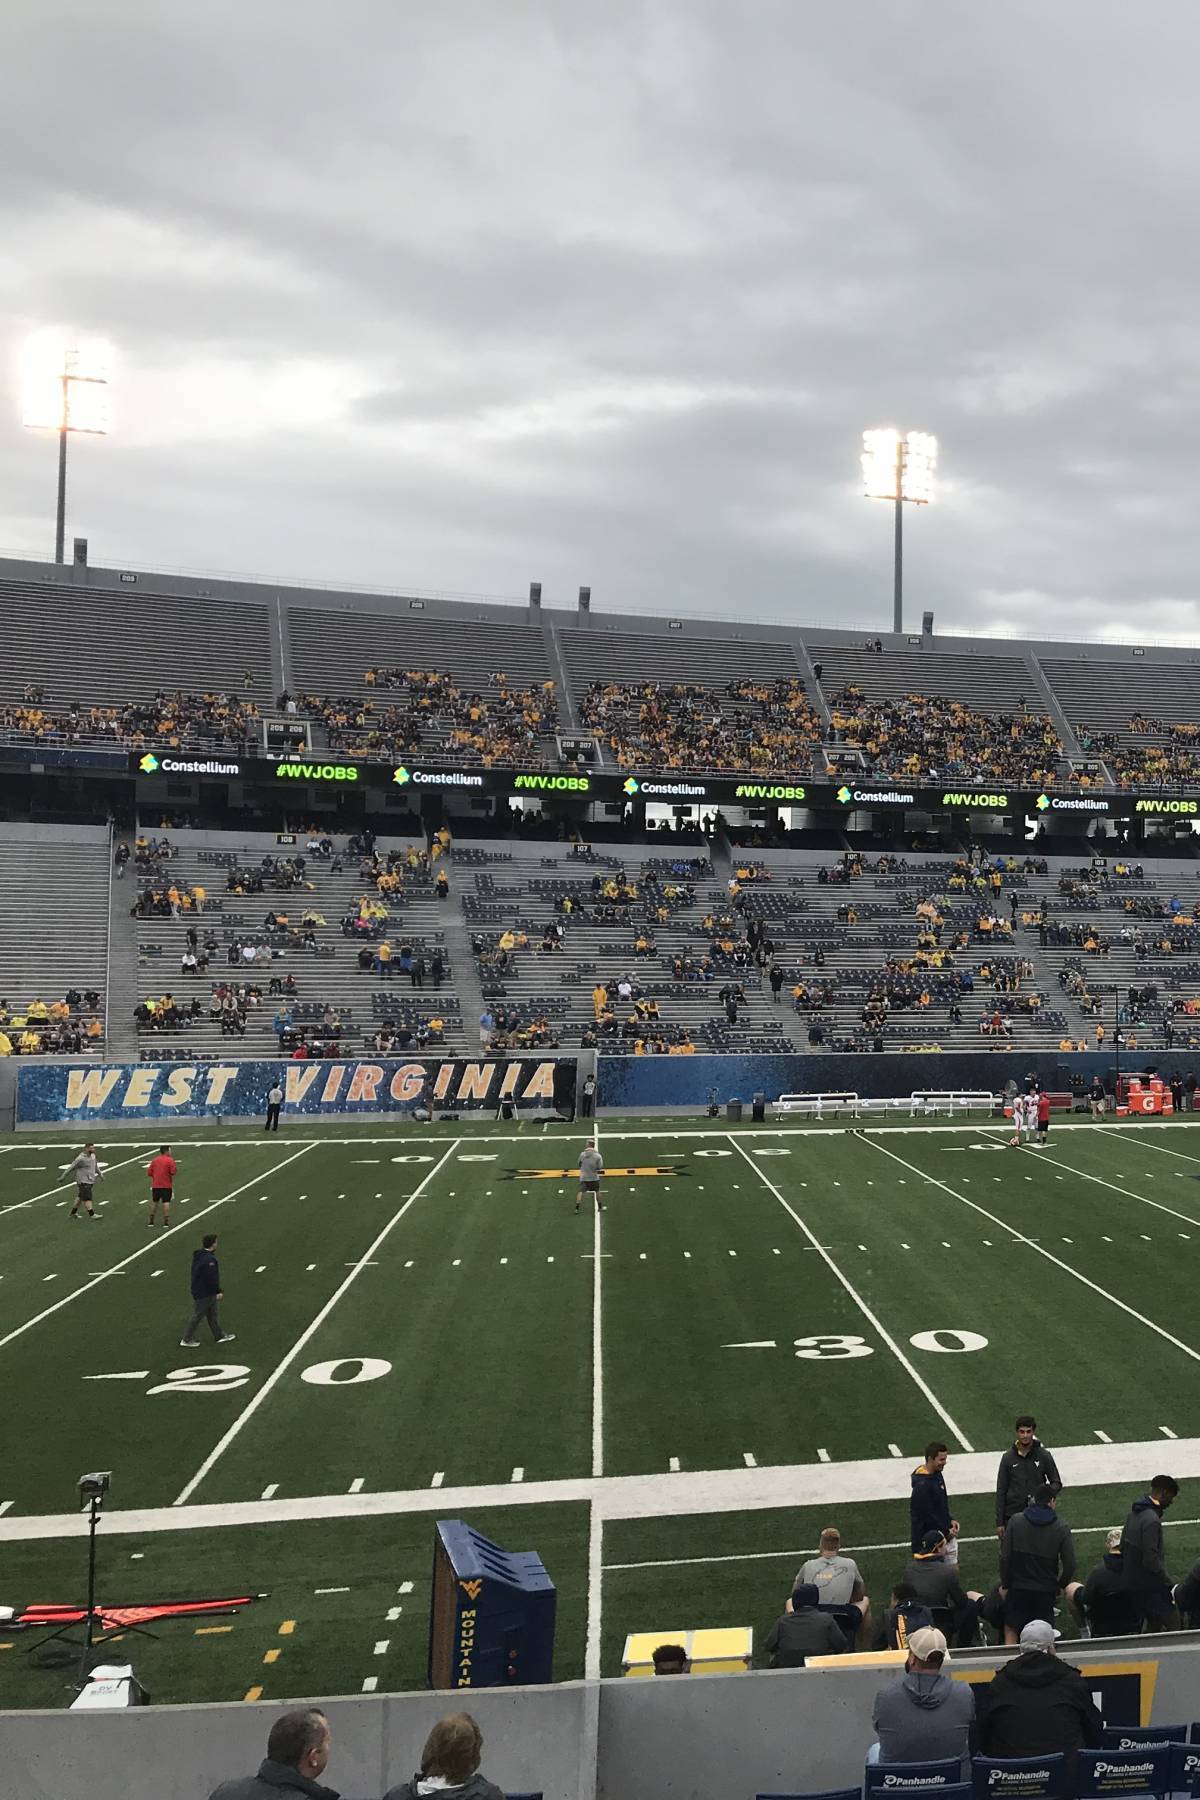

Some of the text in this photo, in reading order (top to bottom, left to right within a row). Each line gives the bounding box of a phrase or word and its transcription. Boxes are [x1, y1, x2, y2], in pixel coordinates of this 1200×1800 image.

[161, 759, 239, 776] Constellium
[276, 763, 358, 781] #WVJOBS
[412, 772, 483, 787] Constellium
[513, 775, 589, 791] #WVJOBS
[640, 782, 706, 796] Constellium
[735, 785, 806, 800] #WVJOBS
[853, 790, 914, 803] Constellium
[942, 793, 1008, 808] #WVJOBS
[1051, 799, 1109, 810] Constellium
[1135, 800, 1198, 813] #WVJOBS
[66, 1062, 556, 1108] WEST VIRGINIA
[1142, 1097, 1154, 1111] G
[1106, 1762, 1155, 1773] Panhandle
[896, 1775, 946, 1786] Panhandle
[1001, 1770, 1051, 1780] Panhandle
